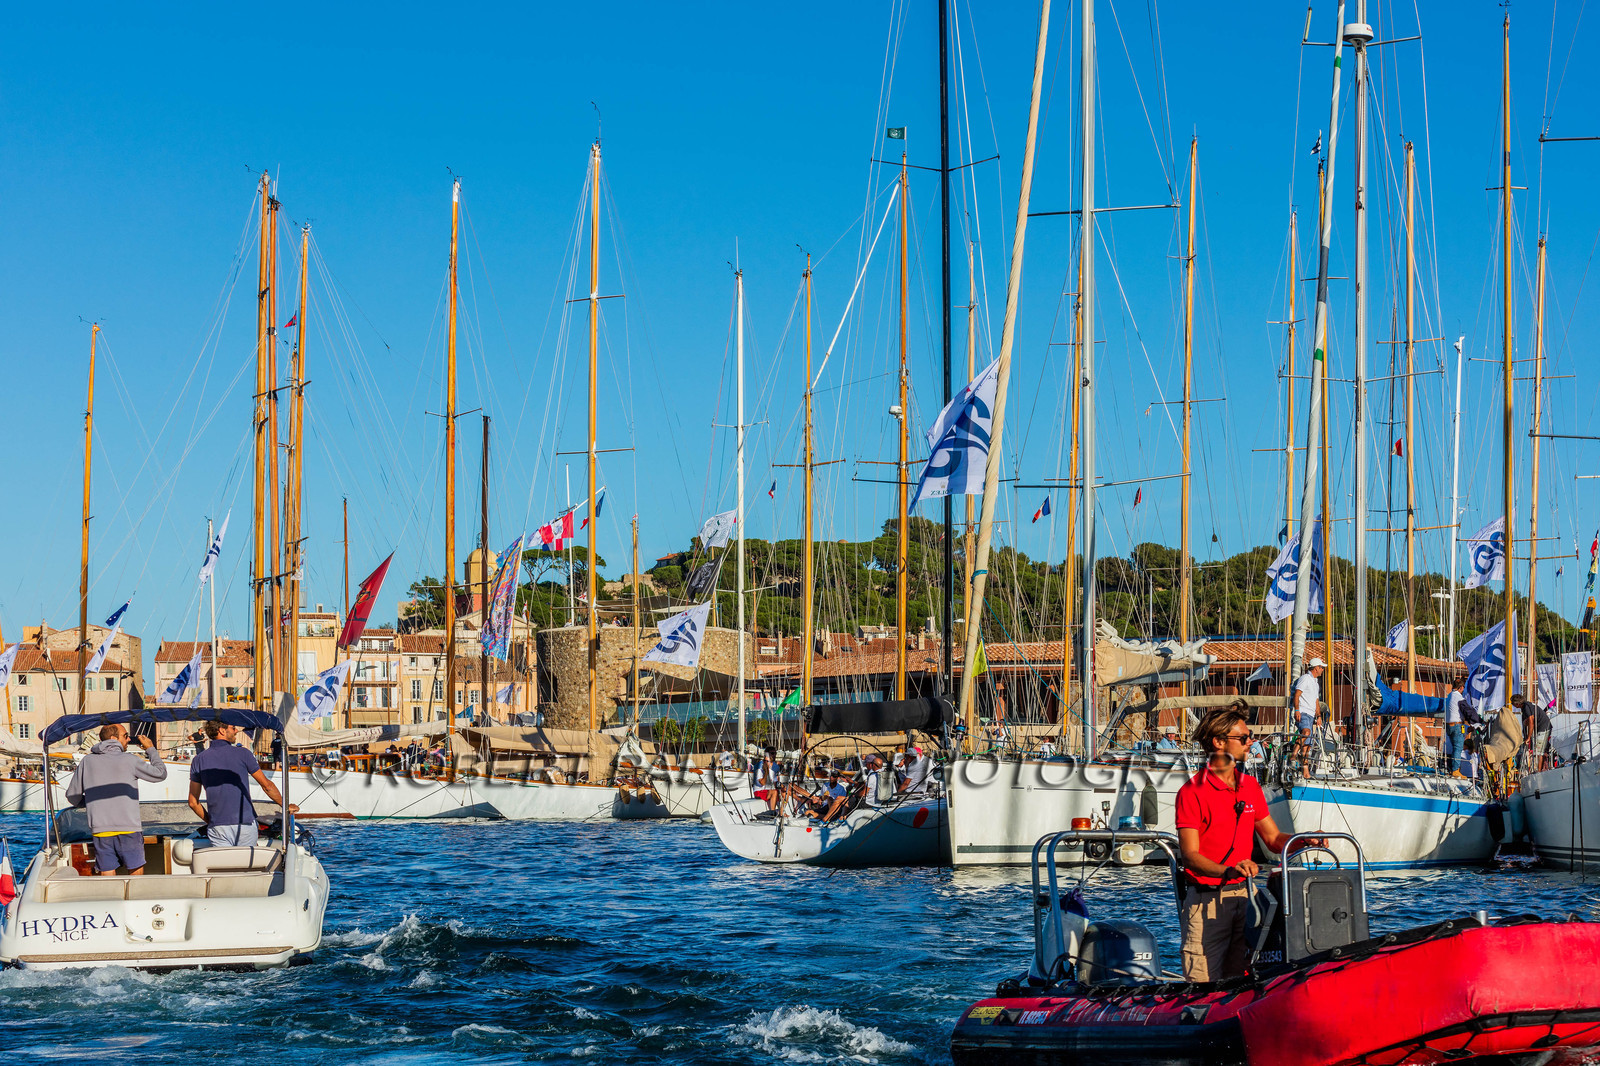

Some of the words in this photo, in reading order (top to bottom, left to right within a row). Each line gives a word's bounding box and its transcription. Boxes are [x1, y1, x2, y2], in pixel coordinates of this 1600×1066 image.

[328, 750, 340, 760] 41
[21, 913, 119, 938] HYDRA
[52, 930, 89, 943] NICE
[1132, 952, 1152, 961] 50
